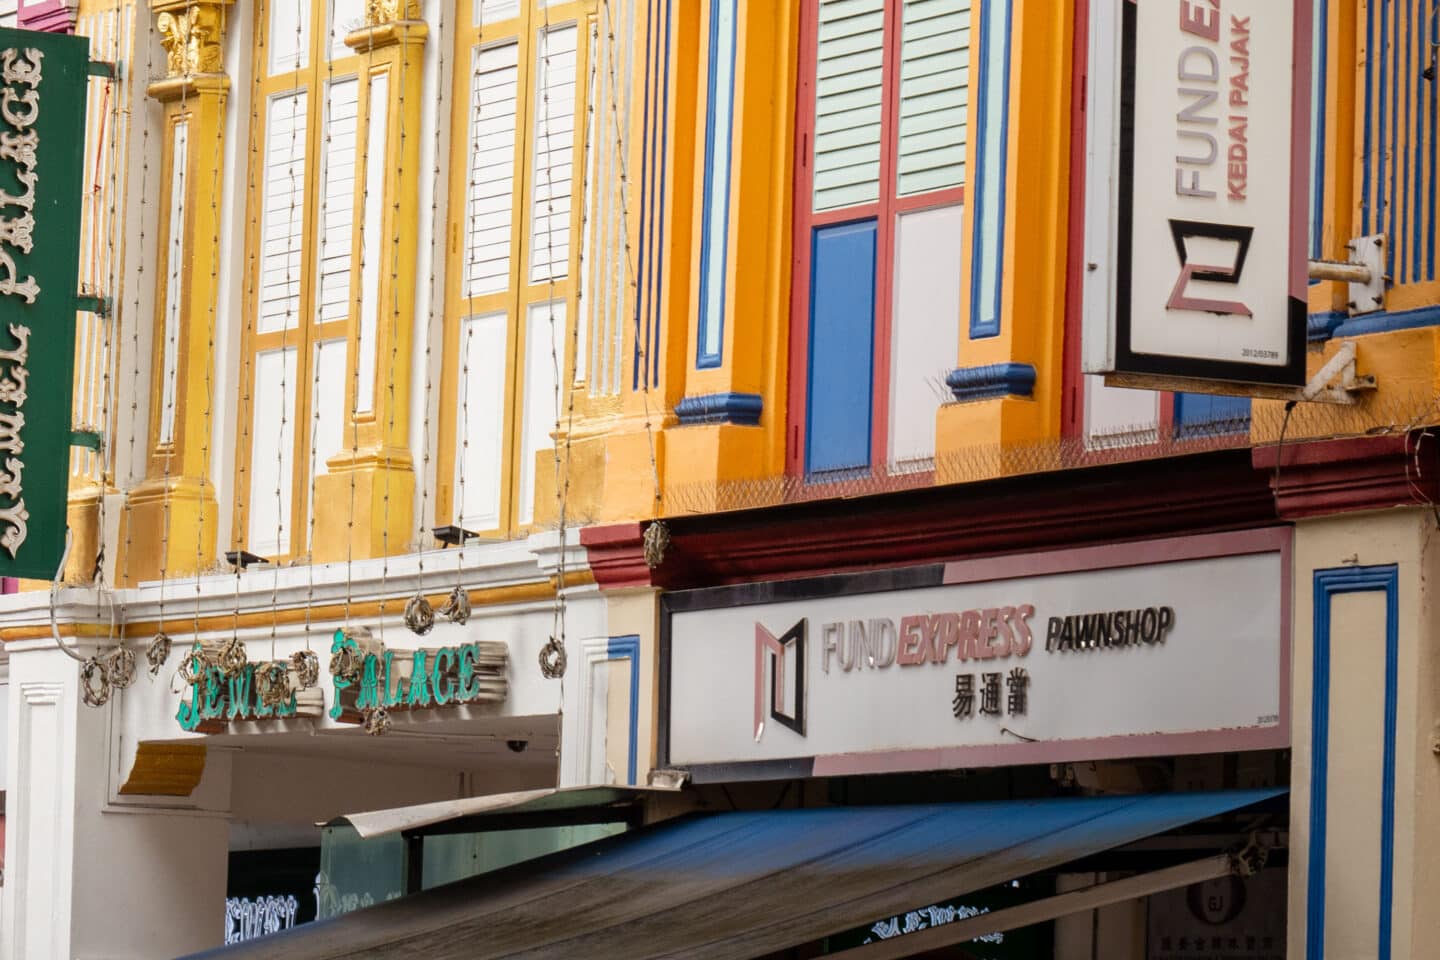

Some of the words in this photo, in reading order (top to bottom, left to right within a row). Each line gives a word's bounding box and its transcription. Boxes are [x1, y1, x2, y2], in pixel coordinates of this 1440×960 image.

[1229, 14, 1251, 107] PAJAK
[1227, 115, 1249, 201] KEDAI
[1046, 606, 1175, 653] PAWNSHOP
